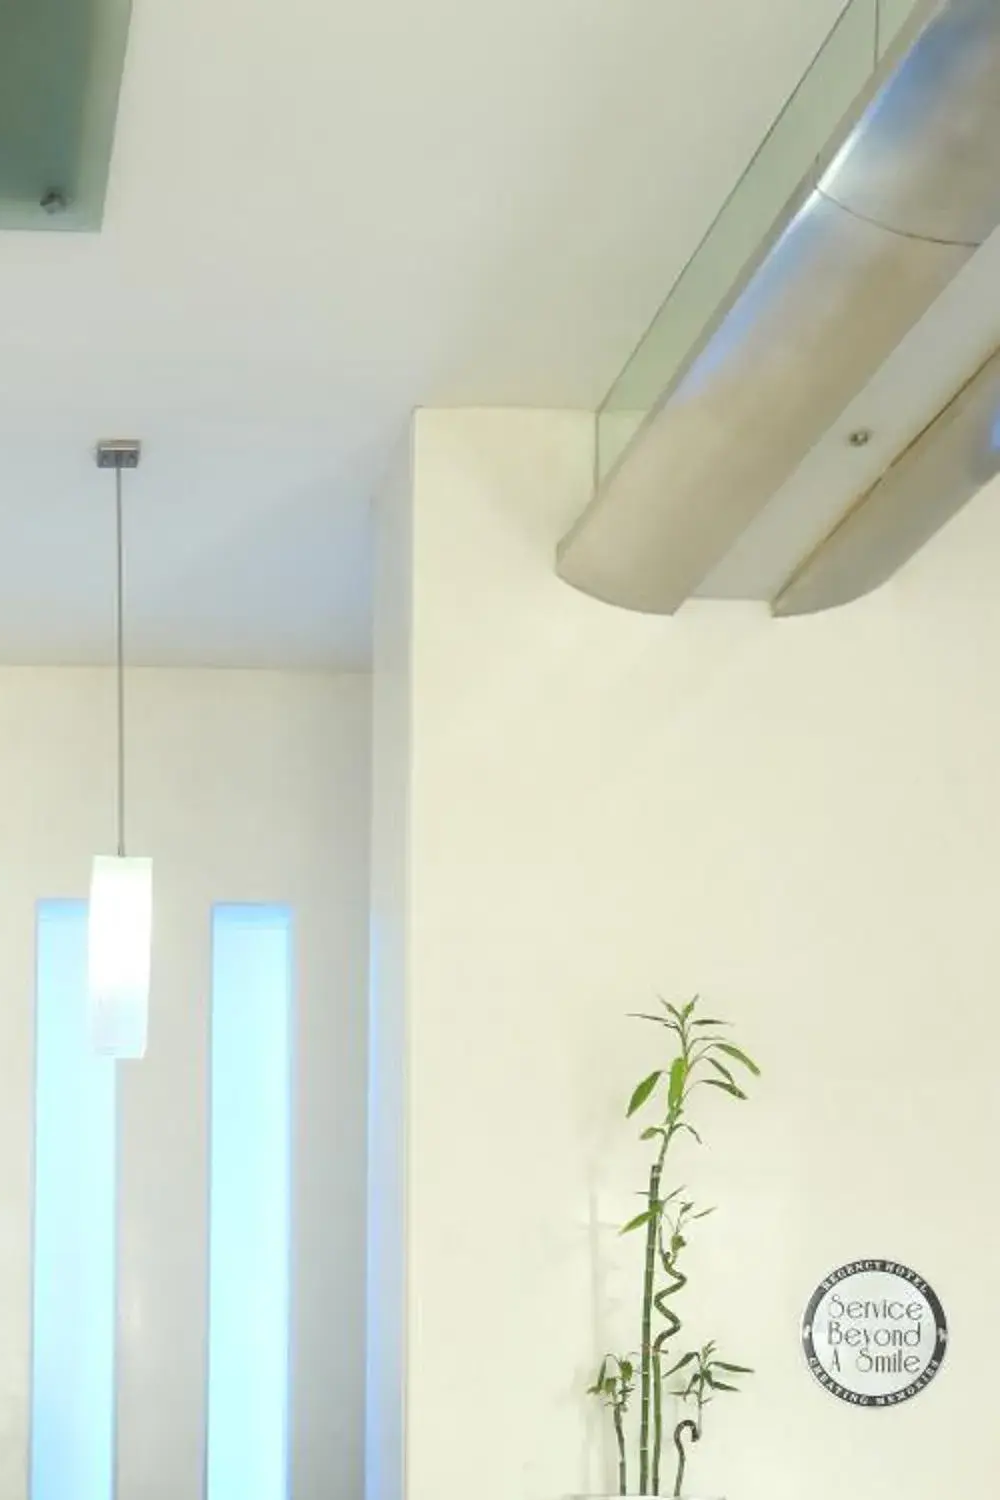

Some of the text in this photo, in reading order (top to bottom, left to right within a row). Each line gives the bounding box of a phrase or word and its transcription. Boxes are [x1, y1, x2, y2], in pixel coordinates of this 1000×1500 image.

[885, 1262, 928, 1293] HOTEL
[827, 1294, 924, 1320] Service
[827, 1321, 921, 1349] Beyond
[829, 1347, 921, 1374] A Smile
[809, 1356, 939, 1405] CREATING MEMORIES
